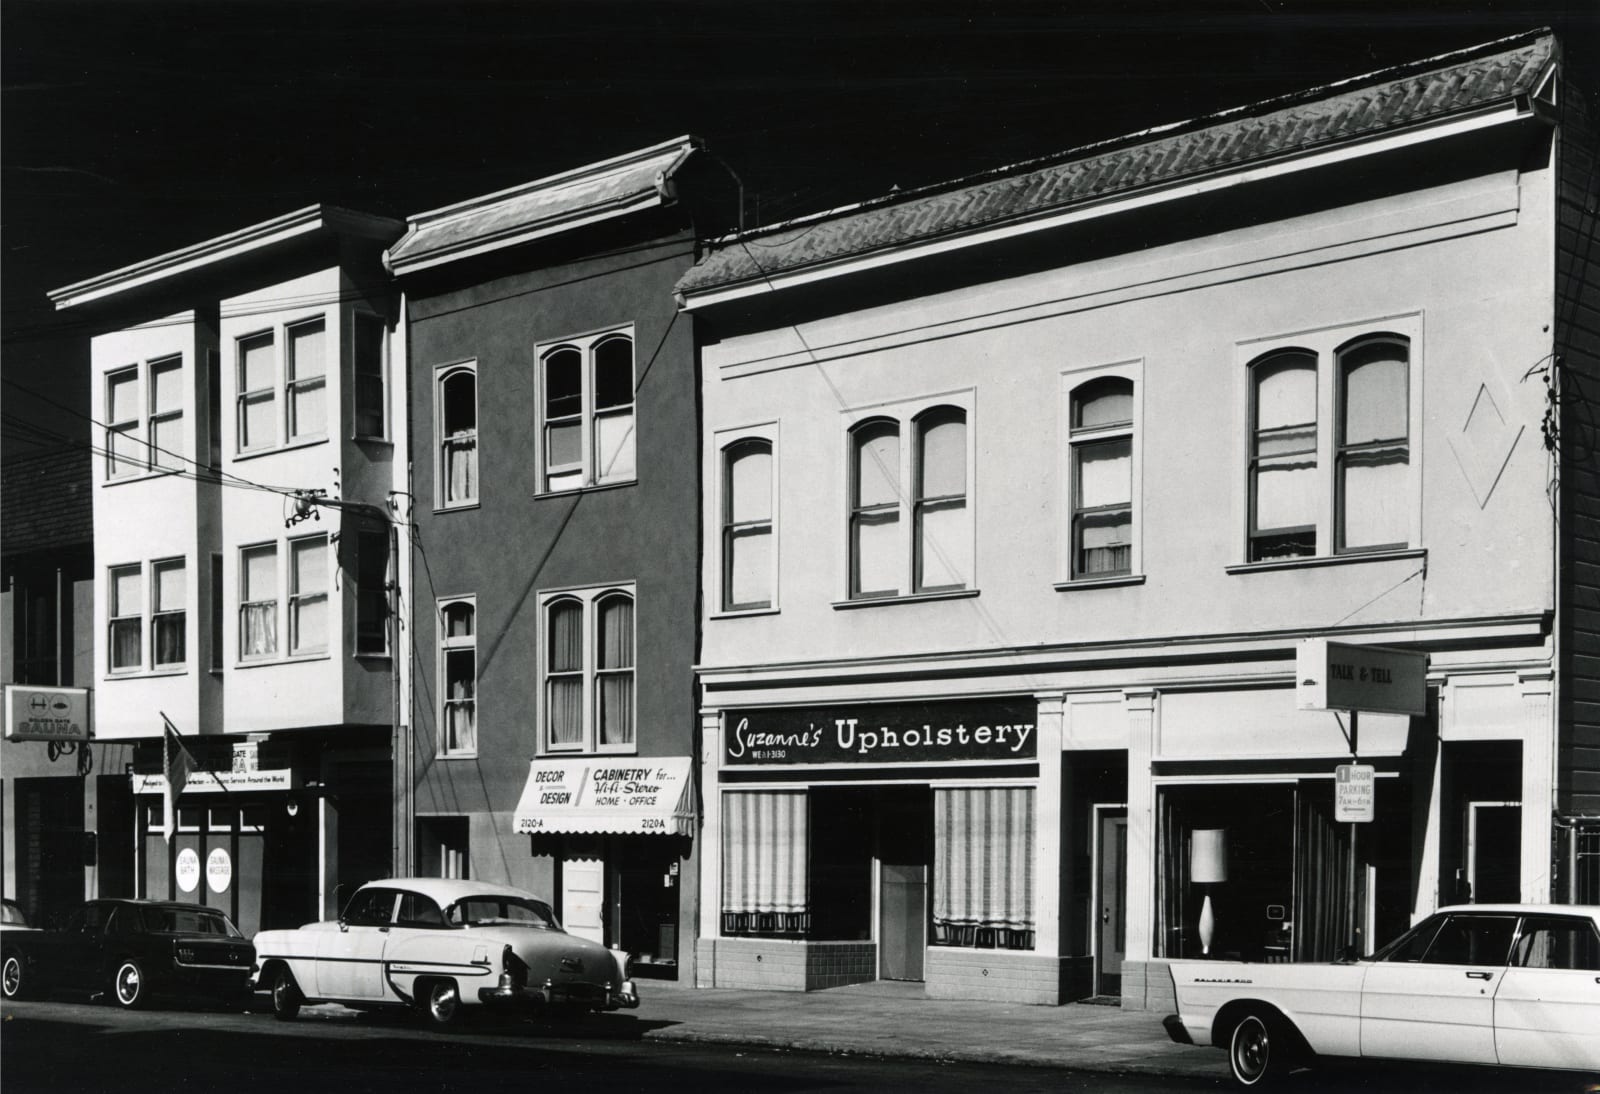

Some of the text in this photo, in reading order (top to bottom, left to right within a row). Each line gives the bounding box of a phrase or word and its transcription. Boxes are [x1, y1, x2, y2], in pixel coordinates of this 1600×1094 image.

[1331, 664, 1393, 684] TALK & TELL
[18, 721, 81, 735] SAUNA
[728, 717, 1034, 758] Suzanne's Upholstery
[535, 770, 565, 783] DECOR
[593, 767, 652, 781] CABINETRY
[1351, 771, 1371, 781] HOUR
[1339, 784, 1371, 796] PARKING
[540, 792, 572, 804] DESIGN
[595, 796, 657, 806] HOME OFFICE
[520, 819, 543, 828] 2120-A
[641, 819, 666, 829] 2120-A
